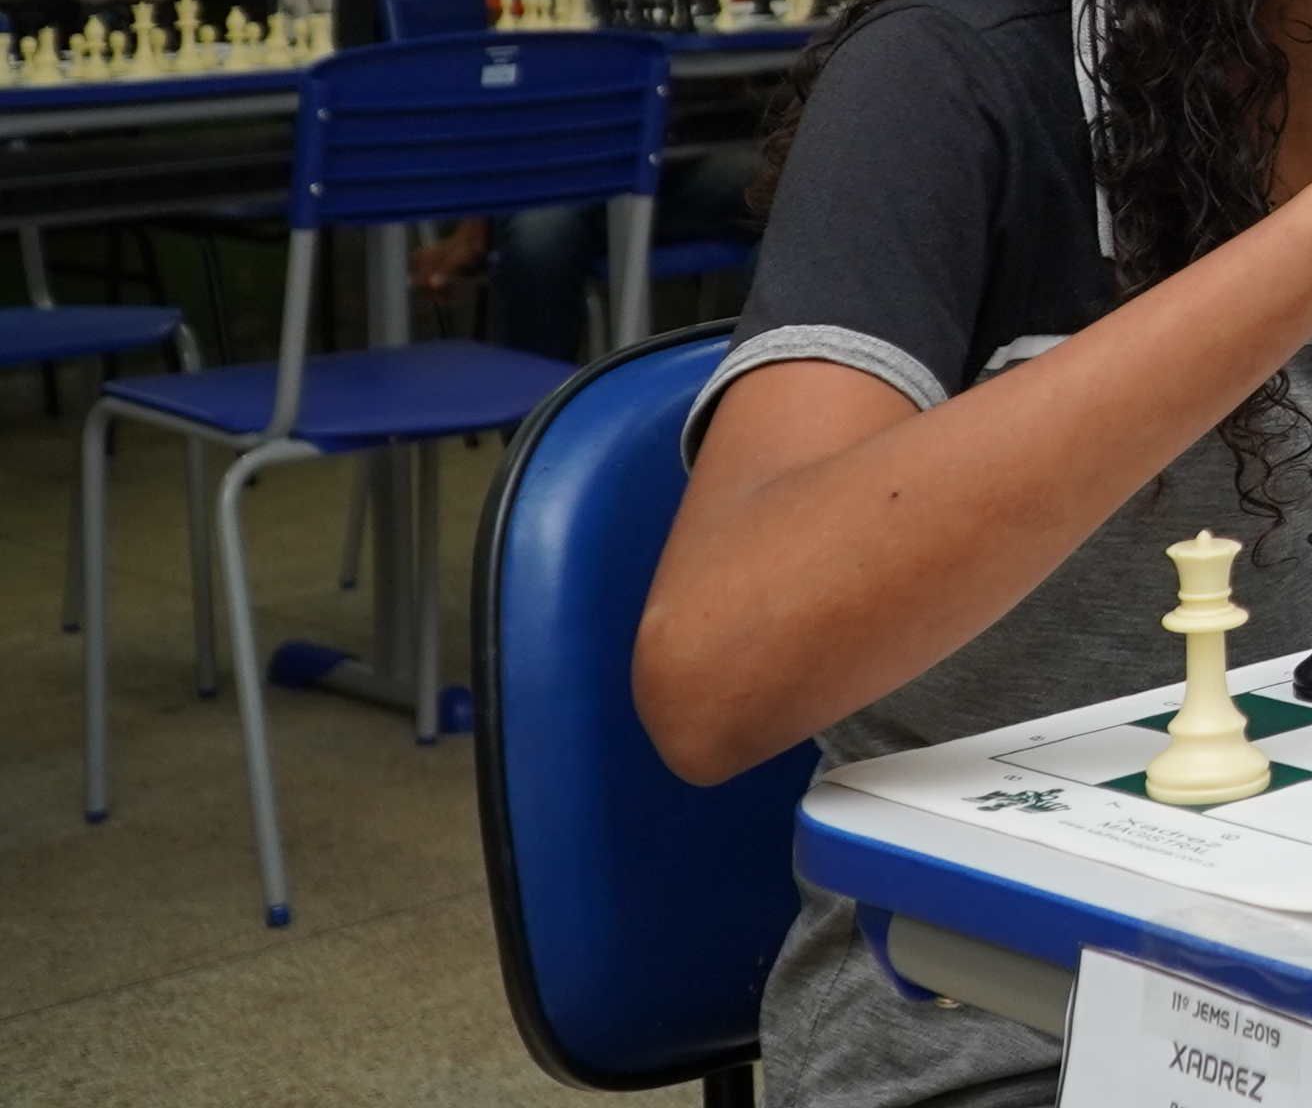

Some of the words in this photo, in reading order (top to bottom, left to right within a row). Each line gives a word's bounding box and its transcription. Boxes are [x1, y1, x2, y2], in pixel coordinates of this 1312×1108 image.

[1096, 820, 1210, 856] MAGISTRAL
[1192, 1000, 1230, 1031] JEMS
[1242, 1018, 1281, 1049] 2019
[1168, 1041, 1267, 1103] XADREZ
